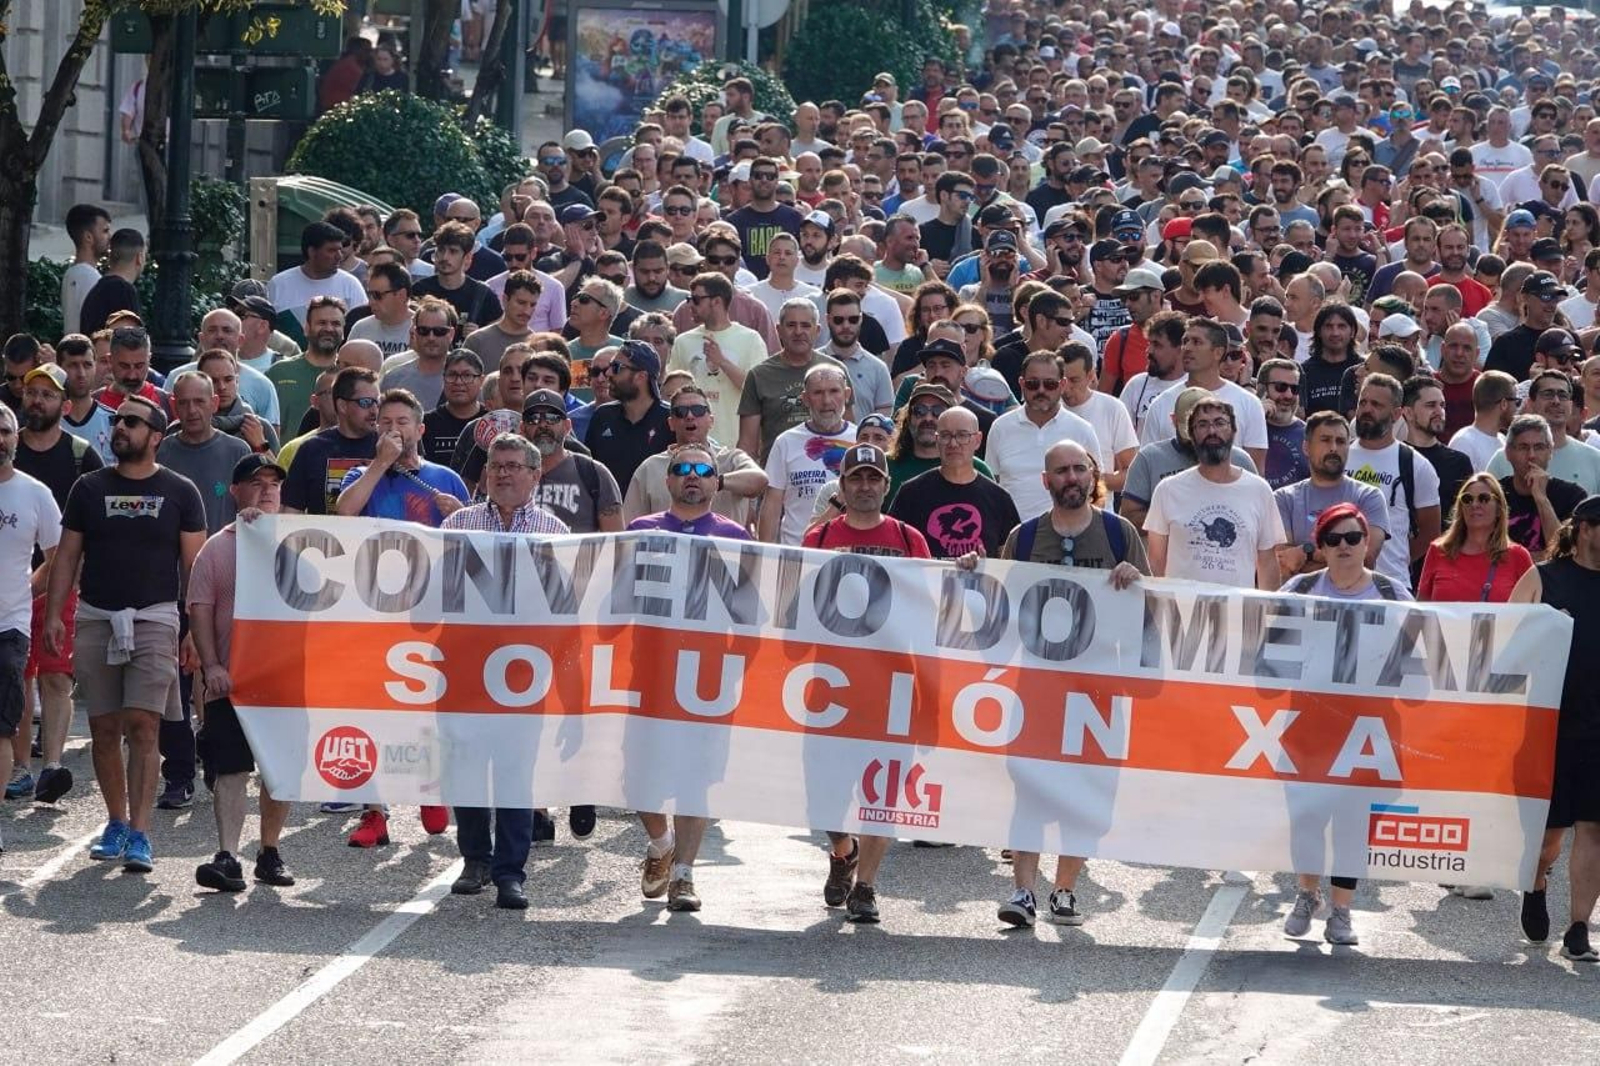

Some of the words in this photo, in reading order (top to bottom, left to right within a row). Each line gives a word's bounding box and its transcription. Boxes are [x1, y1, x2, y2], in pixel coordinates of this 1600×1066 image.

[789, 470, 827, 482] CARREIRA
[275, 528, 893, 638] CONVENIO
[935, 569, 1097, 662] DO
[1140, 589, 1528, 695] METAL
[384, 640, 1133, 760] SOLUCIÓN
[1224, 705, 1404, 782] XA
[322, 736, 369, 762] UGT
[862, 758, 942, 812] CIG
[860, 808, 937, 827] INDUSTRIA
[1375, 820, 1462, 844] CCOO
[1368, 848, 1466, 872] industria
